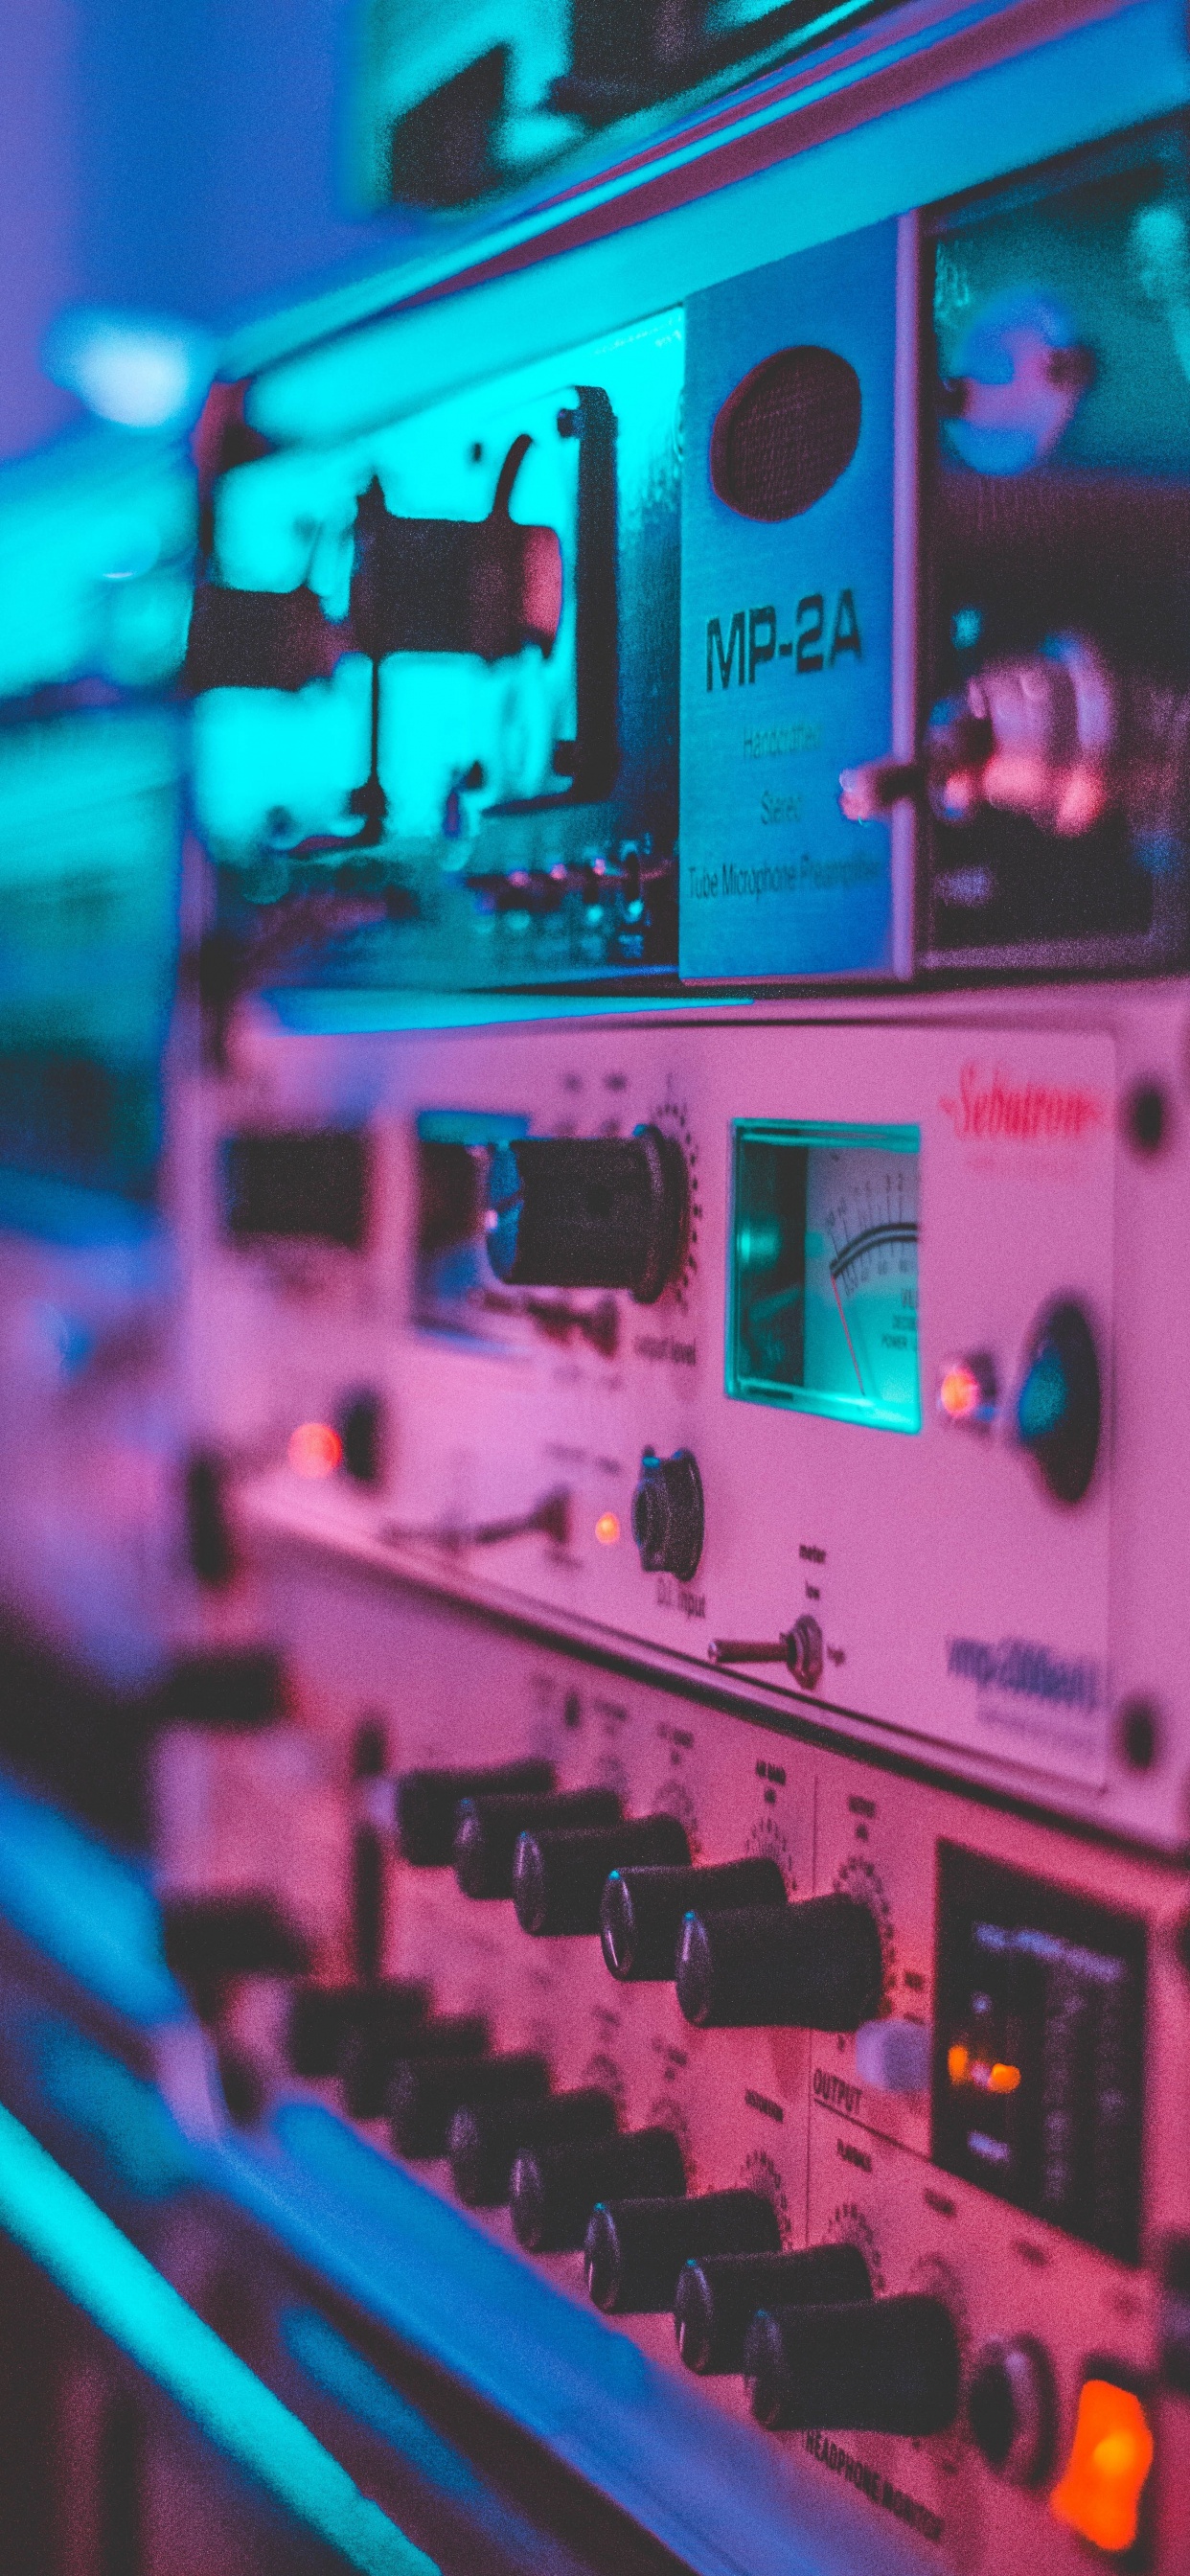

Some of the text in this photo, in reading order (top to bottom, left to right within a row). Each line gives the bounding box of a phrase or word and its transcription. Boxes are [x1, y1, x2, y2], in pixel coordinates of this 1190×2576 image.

[706, 587, 862, 693] MP-2A
[688, 864, 719, 899] Tube
[721, 856, 796, 905] Microphone
[813, 2068, 862, 2114] OUTPUT
[806, 2429, 880, 2503] HEADPHONE
